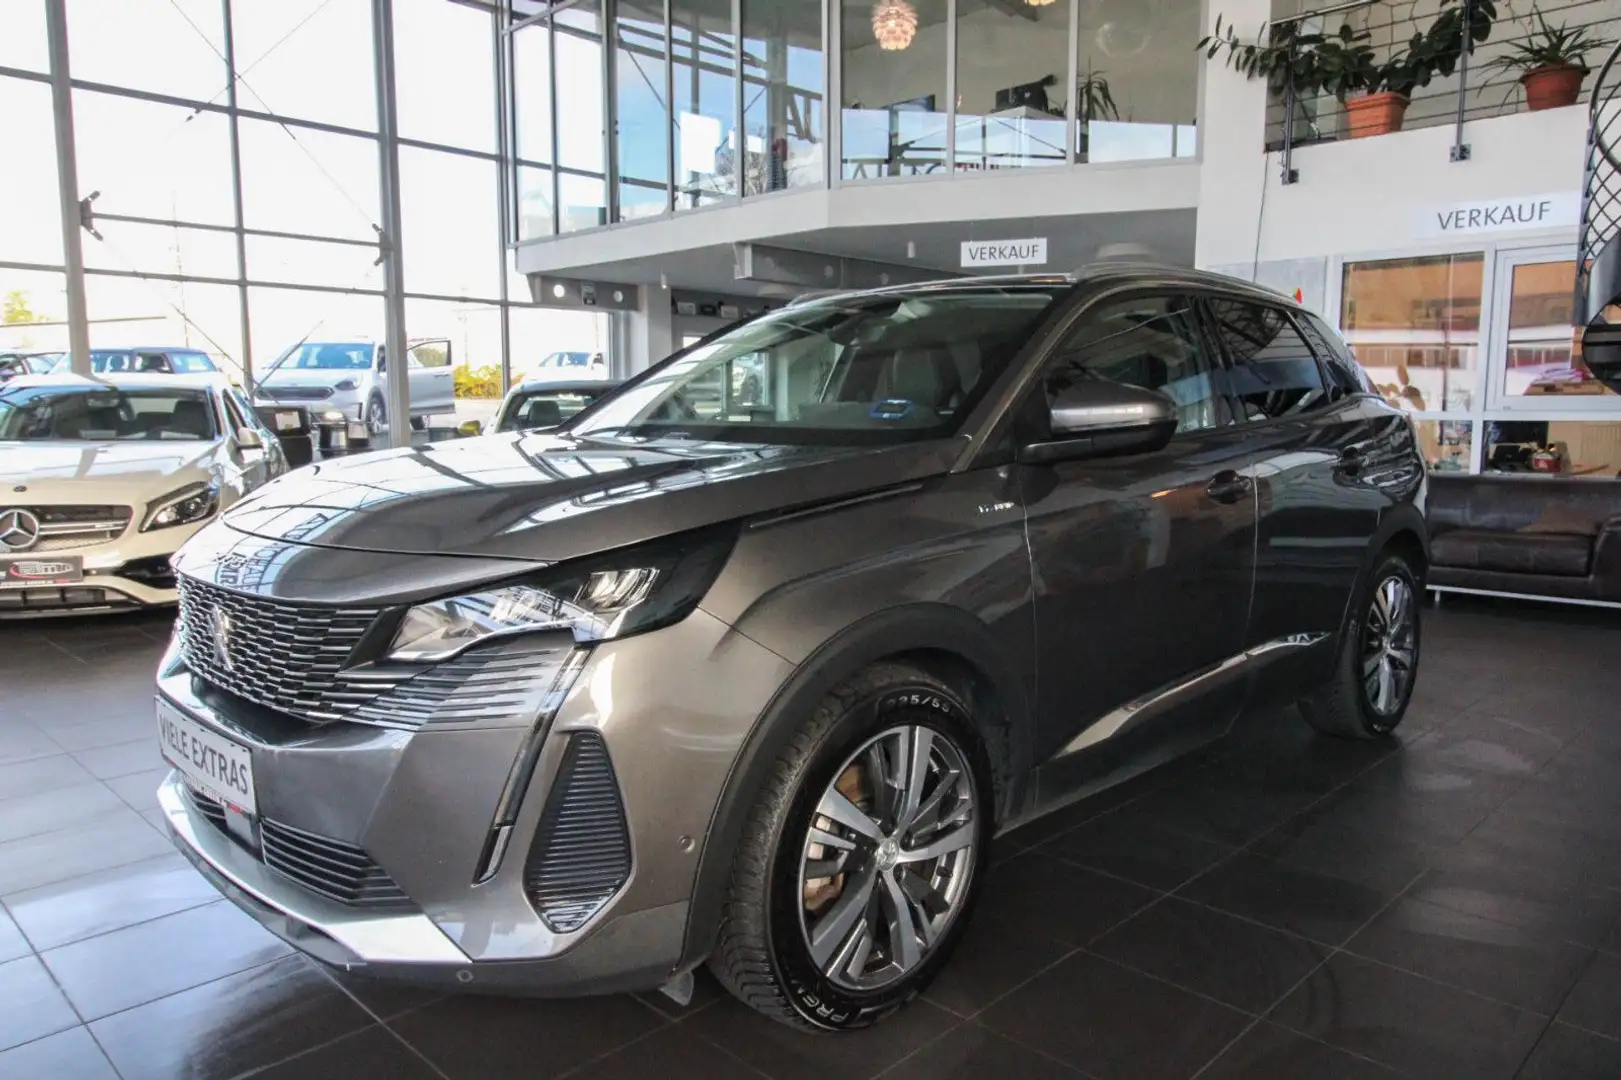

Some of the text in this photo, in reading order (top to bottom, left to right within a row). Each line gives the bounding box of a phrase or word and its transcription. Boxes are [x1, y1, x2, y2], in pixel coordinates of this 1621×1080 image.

[1437, 201, 1552, 230] VERKAUF
[968, 244, 1039, 261] VERKAUF
[159, 713, 190, 760] VIELE
[190, 735, 248, 795] EXTRAS
